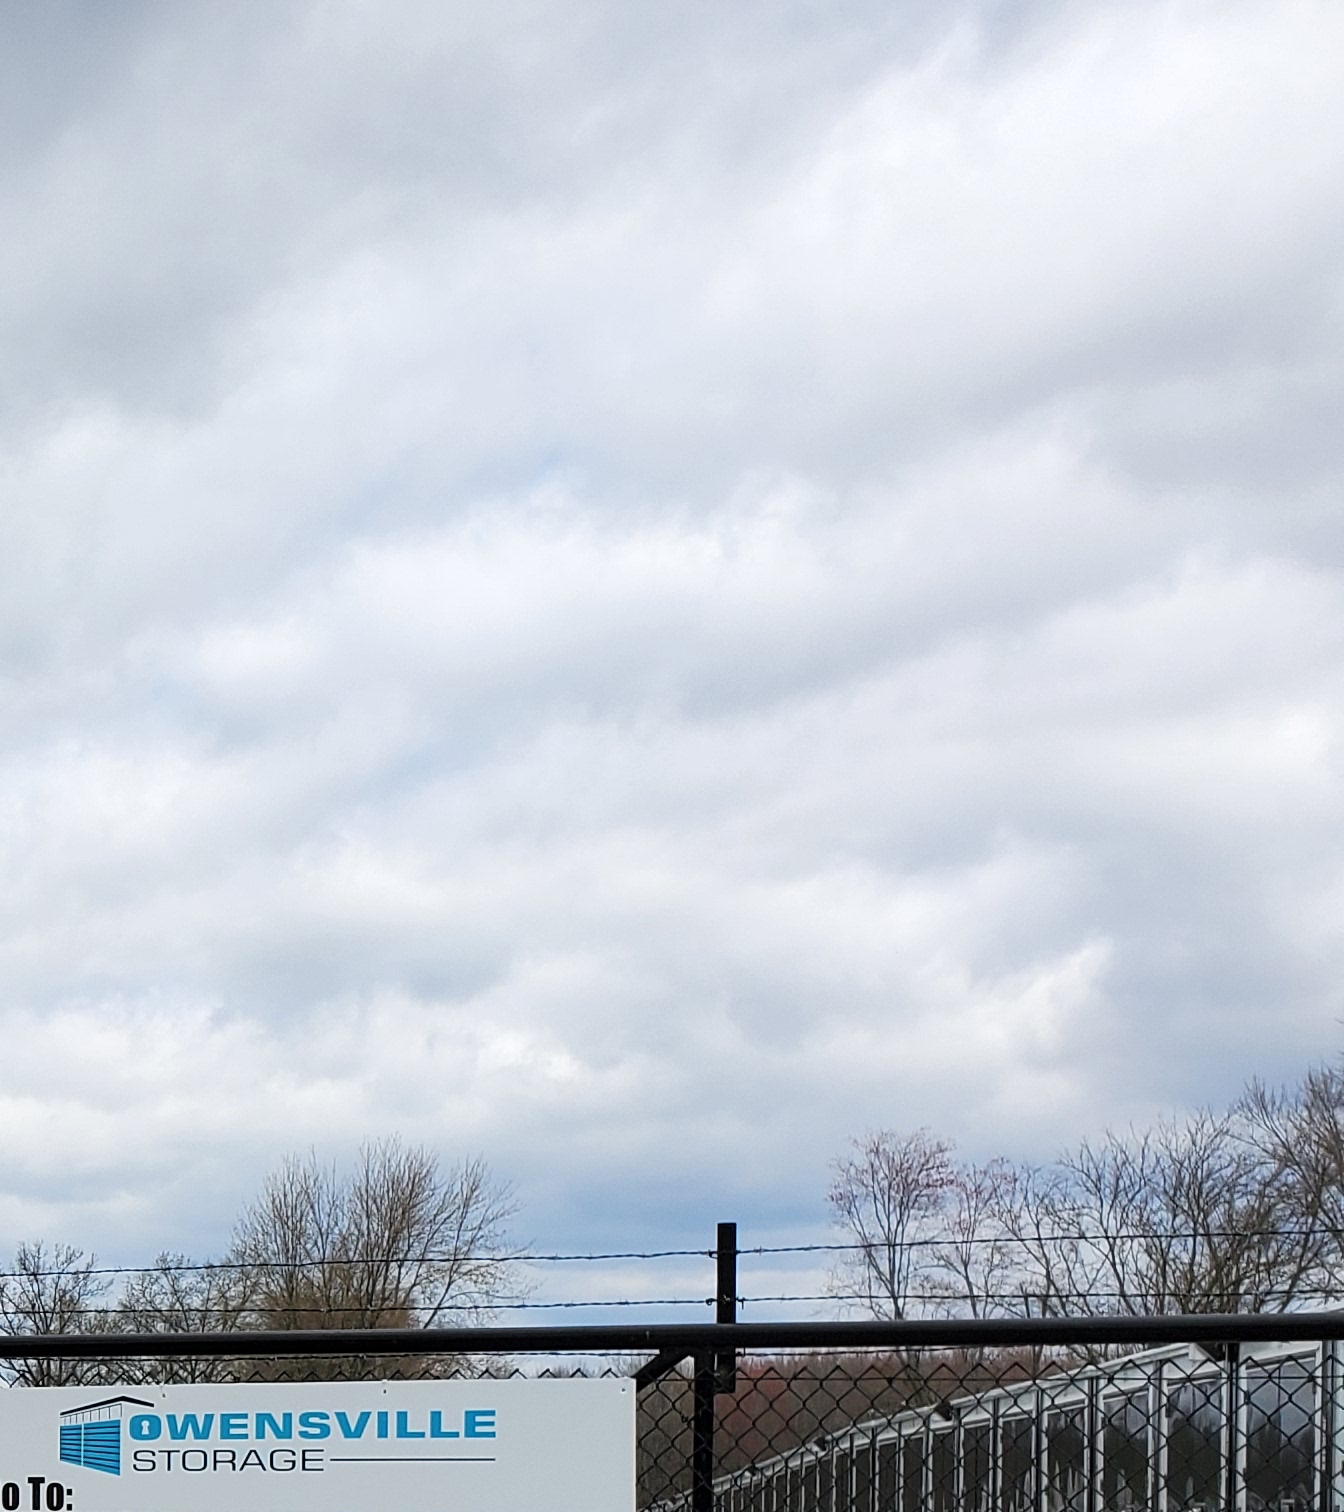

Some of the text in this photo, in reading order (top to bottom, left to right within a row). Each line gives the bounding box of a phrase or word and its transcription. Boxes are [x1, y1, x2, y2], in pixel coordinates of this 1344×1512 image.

[129, 1409, 497, 1441] OWENSVILLE
[132, 1448, 324, 1472] STORAGE
[27, 1479, 74, 1512] To:
